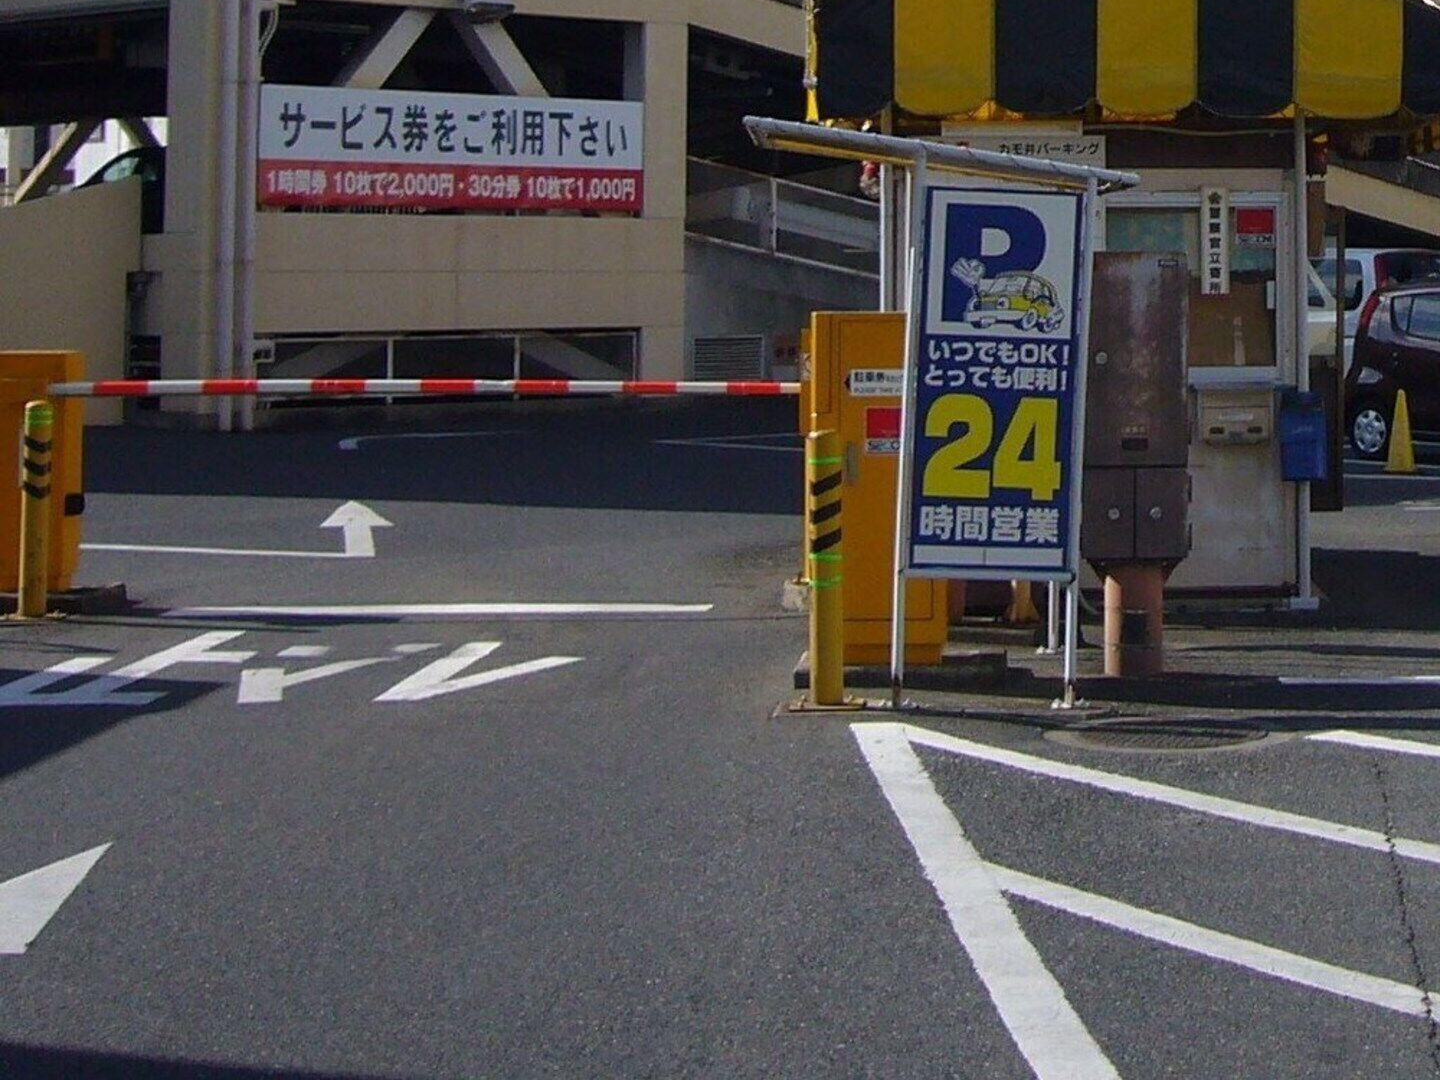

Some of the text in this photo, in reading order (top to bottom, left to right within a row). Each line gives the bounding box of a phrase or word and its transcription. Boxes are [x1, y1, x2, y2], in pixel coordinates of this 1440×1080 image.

[280, 101, 629, 158] サービス券をご利用下さい
[1000, 141, 1100, 156] カモ井パーキング
[941, 203, 1047, 322] P
[928, 340, 1069, 367] いつでもOK!
[925, 365, 1067, 392] とっても便利!
[922, 392, 1061, 501] 24
[919, 506, 1060, 544] 時間営業
